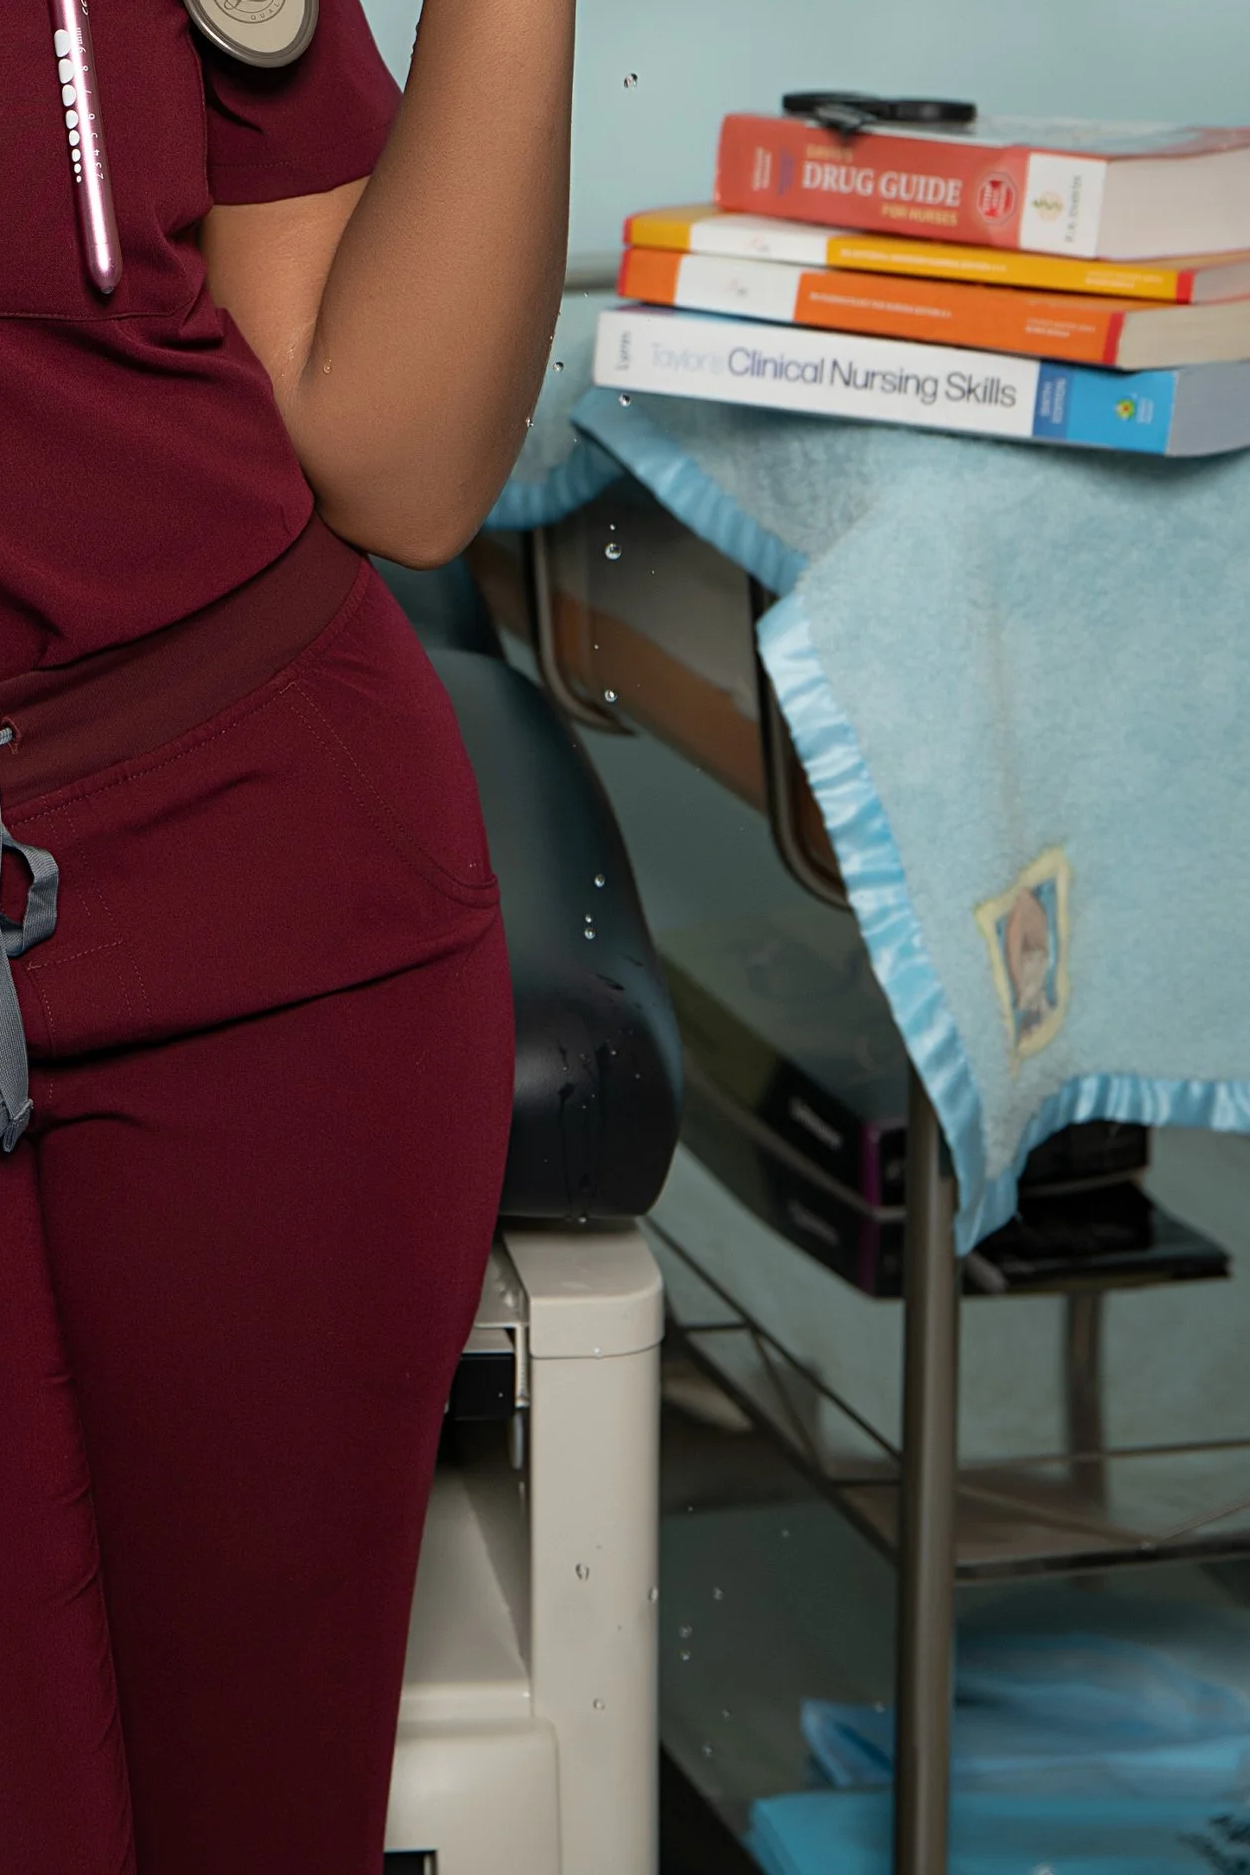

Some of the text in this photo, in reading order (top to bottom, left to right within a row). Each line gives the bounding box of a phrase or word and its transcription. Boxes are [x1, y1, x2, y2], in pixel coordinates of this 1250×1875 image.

[803, 159, 875, 197] DRUG
[878, 170, 963, 208] GUIDE
[881, 203, 958, 226] FOR NURSES
[728, 346, 825, 386] Clinical
[830, 358, 939, 406] Nursing
[945, 370, 1017, 408] Skills
